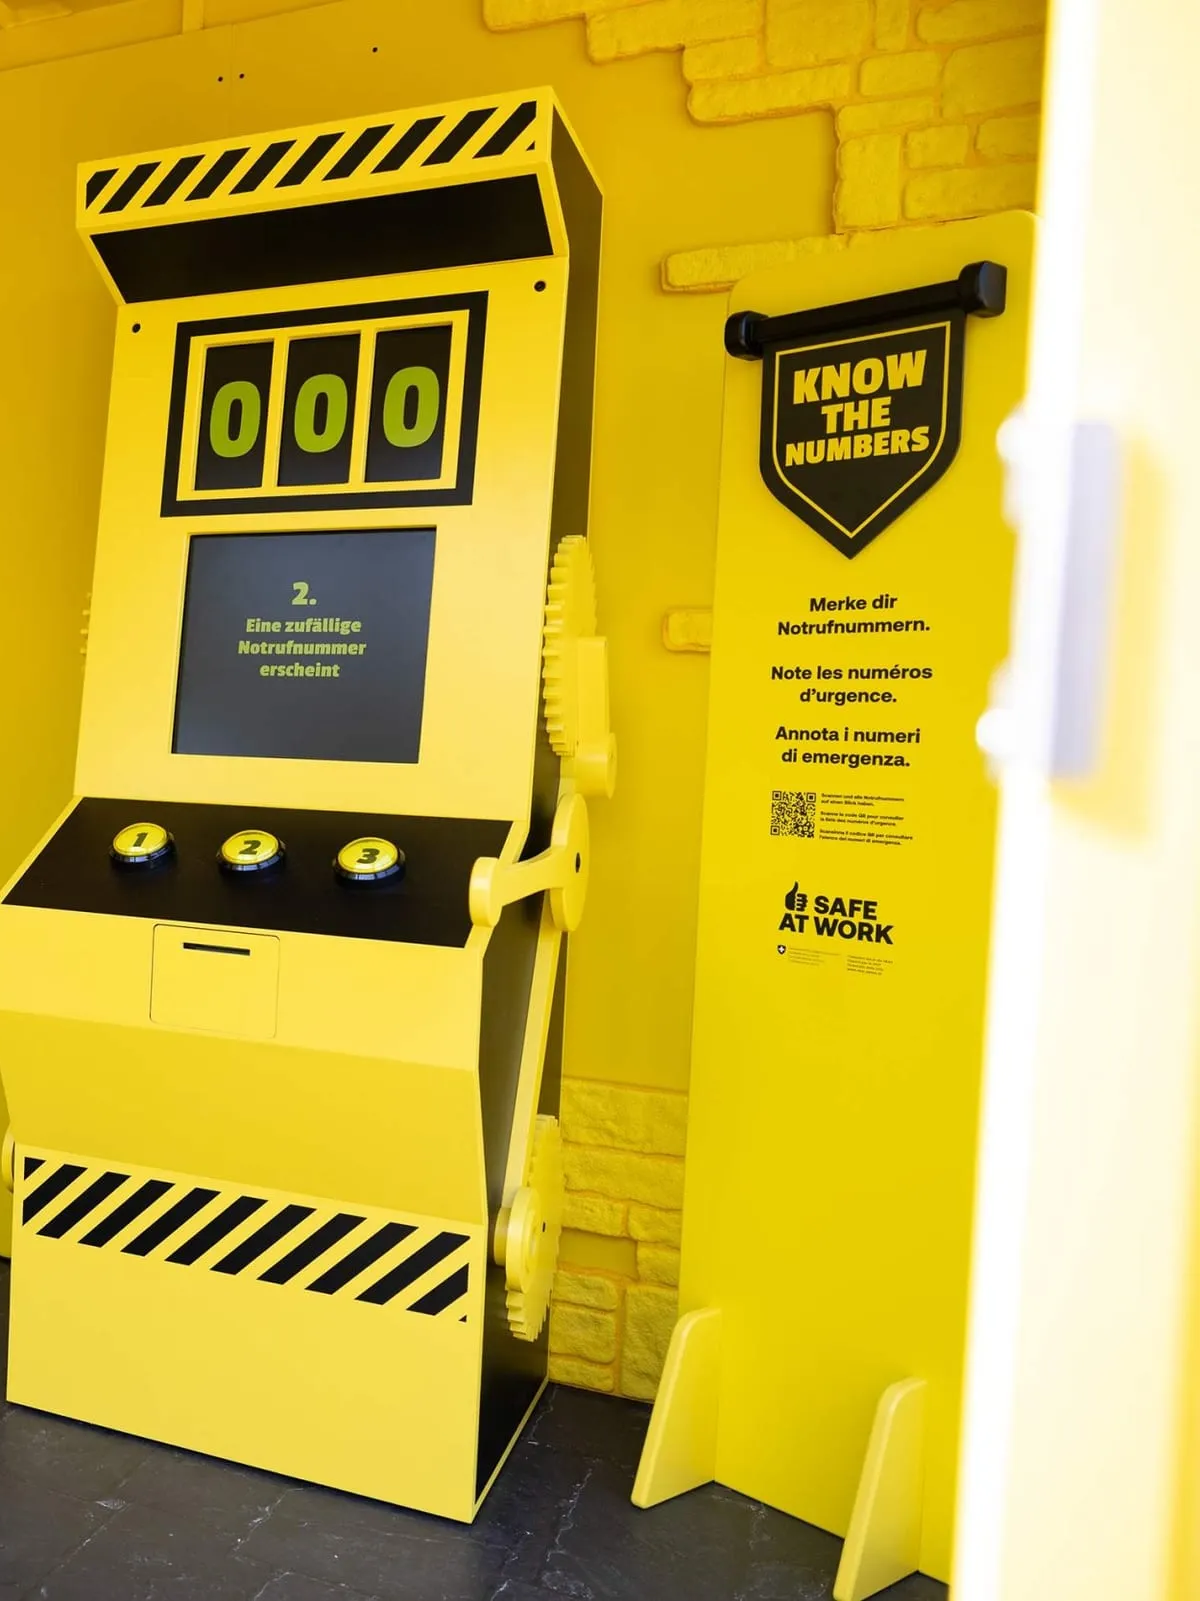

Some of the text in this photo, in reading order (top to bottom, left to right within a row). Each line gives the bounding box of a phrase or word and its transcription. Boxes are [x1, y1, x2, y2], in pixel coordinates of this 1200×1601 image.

[793, 349, 927, 404] KNOW
[210, 366, 440, 458] 0 0 0
[821, 396, 891, 434] THE
[785, 426, 929, 467] NUMBERS
[292, 582, 317, 605] 2.
[810, 594, 897, 612] Merke dir
[246, 618, 362, 634] Eine zufällige
[778, 620, 930, 635] Notrufnummern.
[238, 640, 366, 655] Notrufnummer
[260, 663, 340, 677] erscheint
[772, 665, 932, 680] Note les numéros
[800, 688, 897, 706] d’urgence.
[776, 726, 920, 743] Annota i numeri
[782, 749, 910, 768] di emergenza.
[133, 832, 148, 847] 1
[239, 840, 261, 855] 2
[356, 848, 380, 864] 3
[814, 895, 878, 920] SAFE
[779, 913, 894, 945] AT WORK
